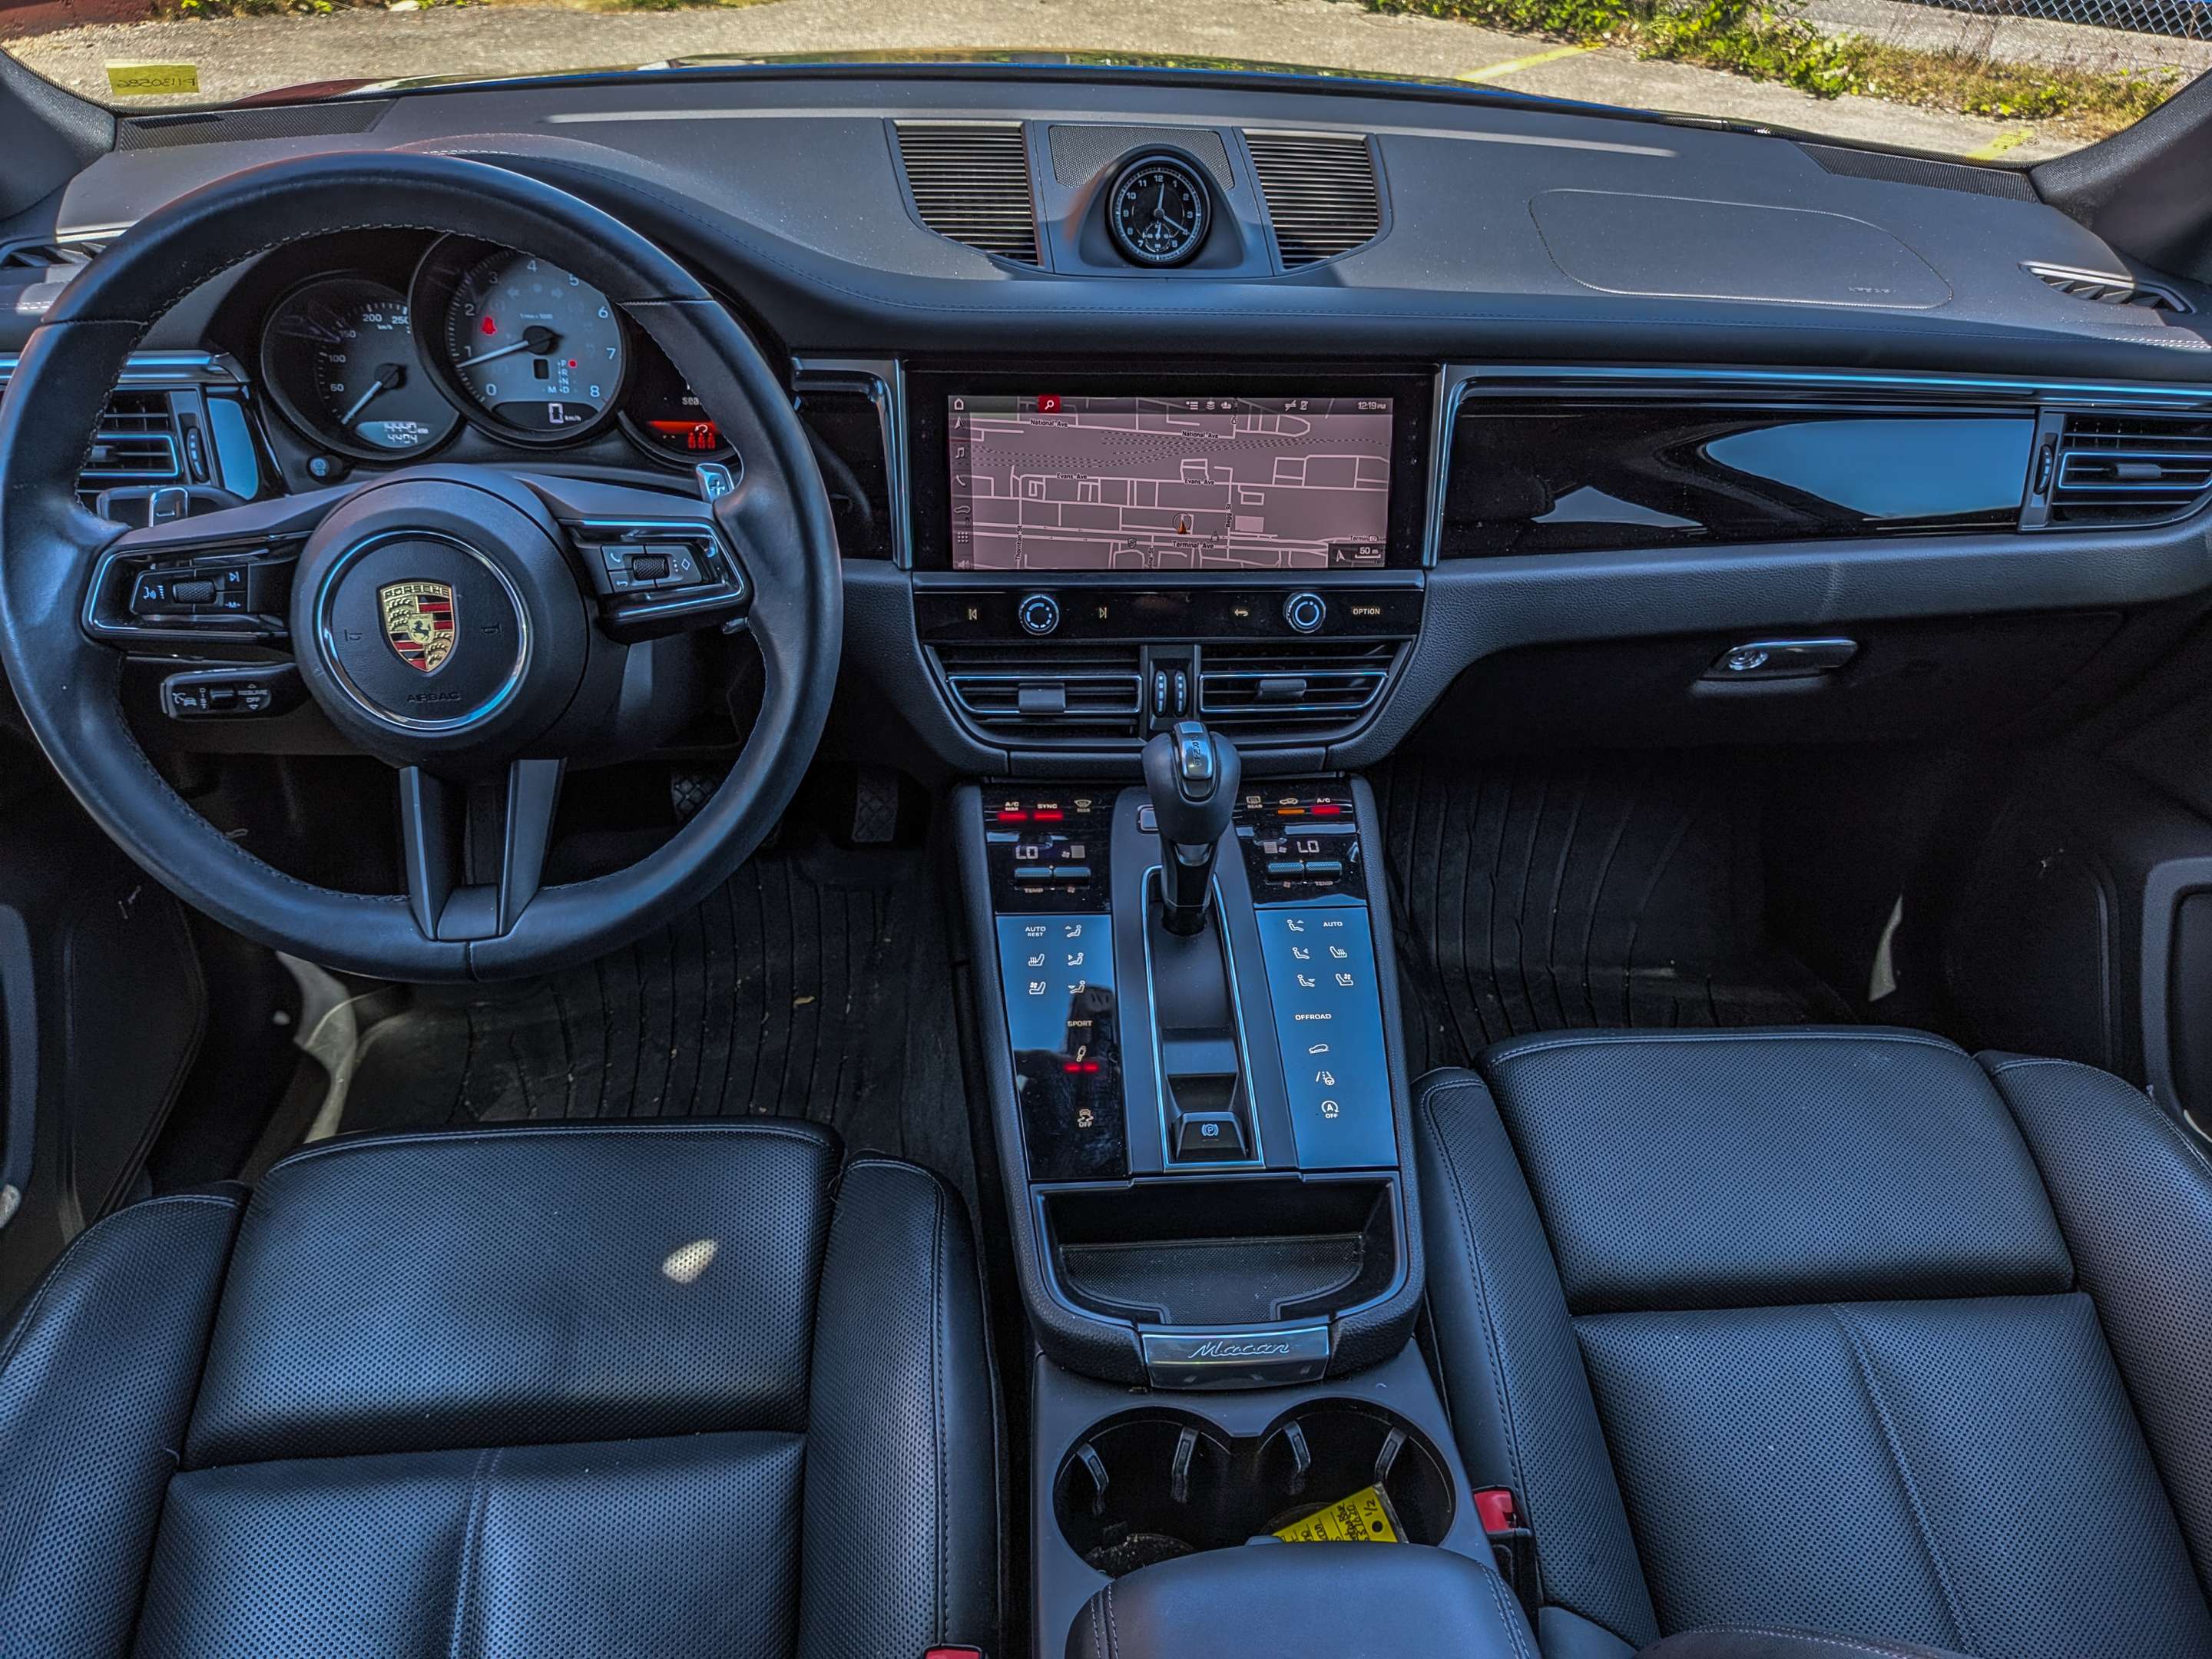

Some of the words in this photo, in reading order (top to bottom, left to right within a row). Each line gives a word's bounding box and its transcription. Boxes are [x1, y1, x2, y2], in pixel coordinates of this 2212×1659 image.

[527, 260, 538, 272] 4
[489, 271, 499, 284] 3
[569, 274, 580, 286] 5
[465, 303, 475, 316] 2
[598, 306, 609, 319] 6
[363, 313, 382, 322] 200
[465, 346, 472, 356] 1
[606, 347, 616, 359] 7
[328, 354, 346, 363] 100
[485, 383, 497, 396] 0
[589, 386, 600, 397] 8
[681, 395, 702, 406] sea
[548, 402, 565, 424] 0
[1017, 525, 1023, 533] St
[1359, 546, 1371, 555] 50
[385, 584, 450, 598] PORSCHE
[1353, 608, 1381, 616] OPTION
[406, 692, 461, 703] AIRBAG
[1296, 840, 1320, 853] LO
[1187, 1340, 1290, 1359] Macan
